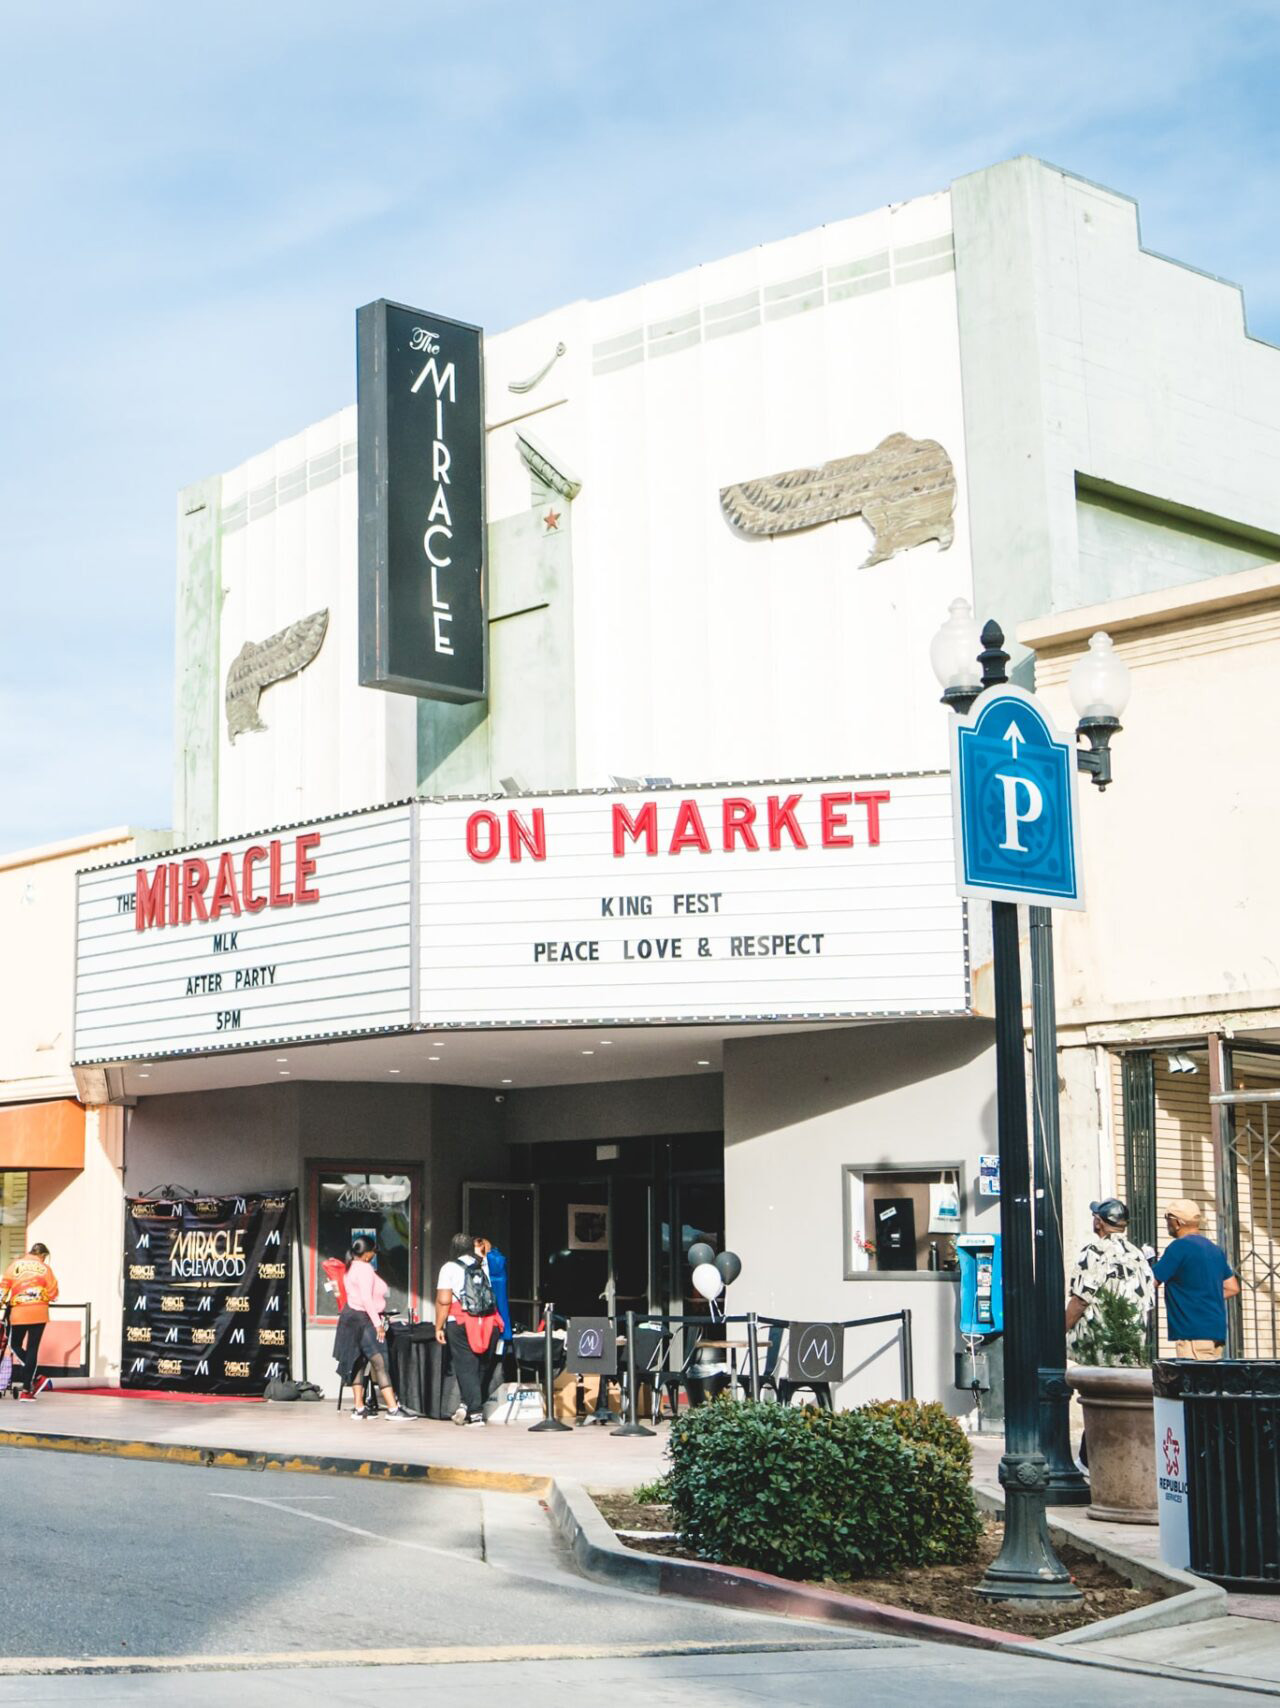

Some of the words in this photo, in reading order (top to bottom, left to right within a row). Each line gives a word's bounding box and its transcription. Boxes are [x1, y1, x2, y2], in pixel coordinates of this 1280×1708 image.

[409, 327, 440, 355] The
[410, 358, 456, 655] MIRACLE
[465, 807, 547, 863] ON
[612, 790, 891, 859] MARKET
[995, 773, 1043, 852] P
[117, 893, 137, 913] THE
[135, 832, 321, 932] MIRACLE
[601, 894, 653, 917] KING
[673, 892, 722, 915] FEST
[213, 931, 238, 953] MLK
[533, 941, 600, 963] PEACE
[623, 938, 682, 960] LOVE
[697, 937, 712, 957] &
[730, 933, 825, 957] RESPECT
[186, 973, 222, 995] AFTER
[235, 965, 276, 988] PARTY
[216, 1010, 241, 1030] 5PM
[169, 1229, 246, 1261] MIRACLE
[171, 1258, 246, 1277] INGLEWOOD
